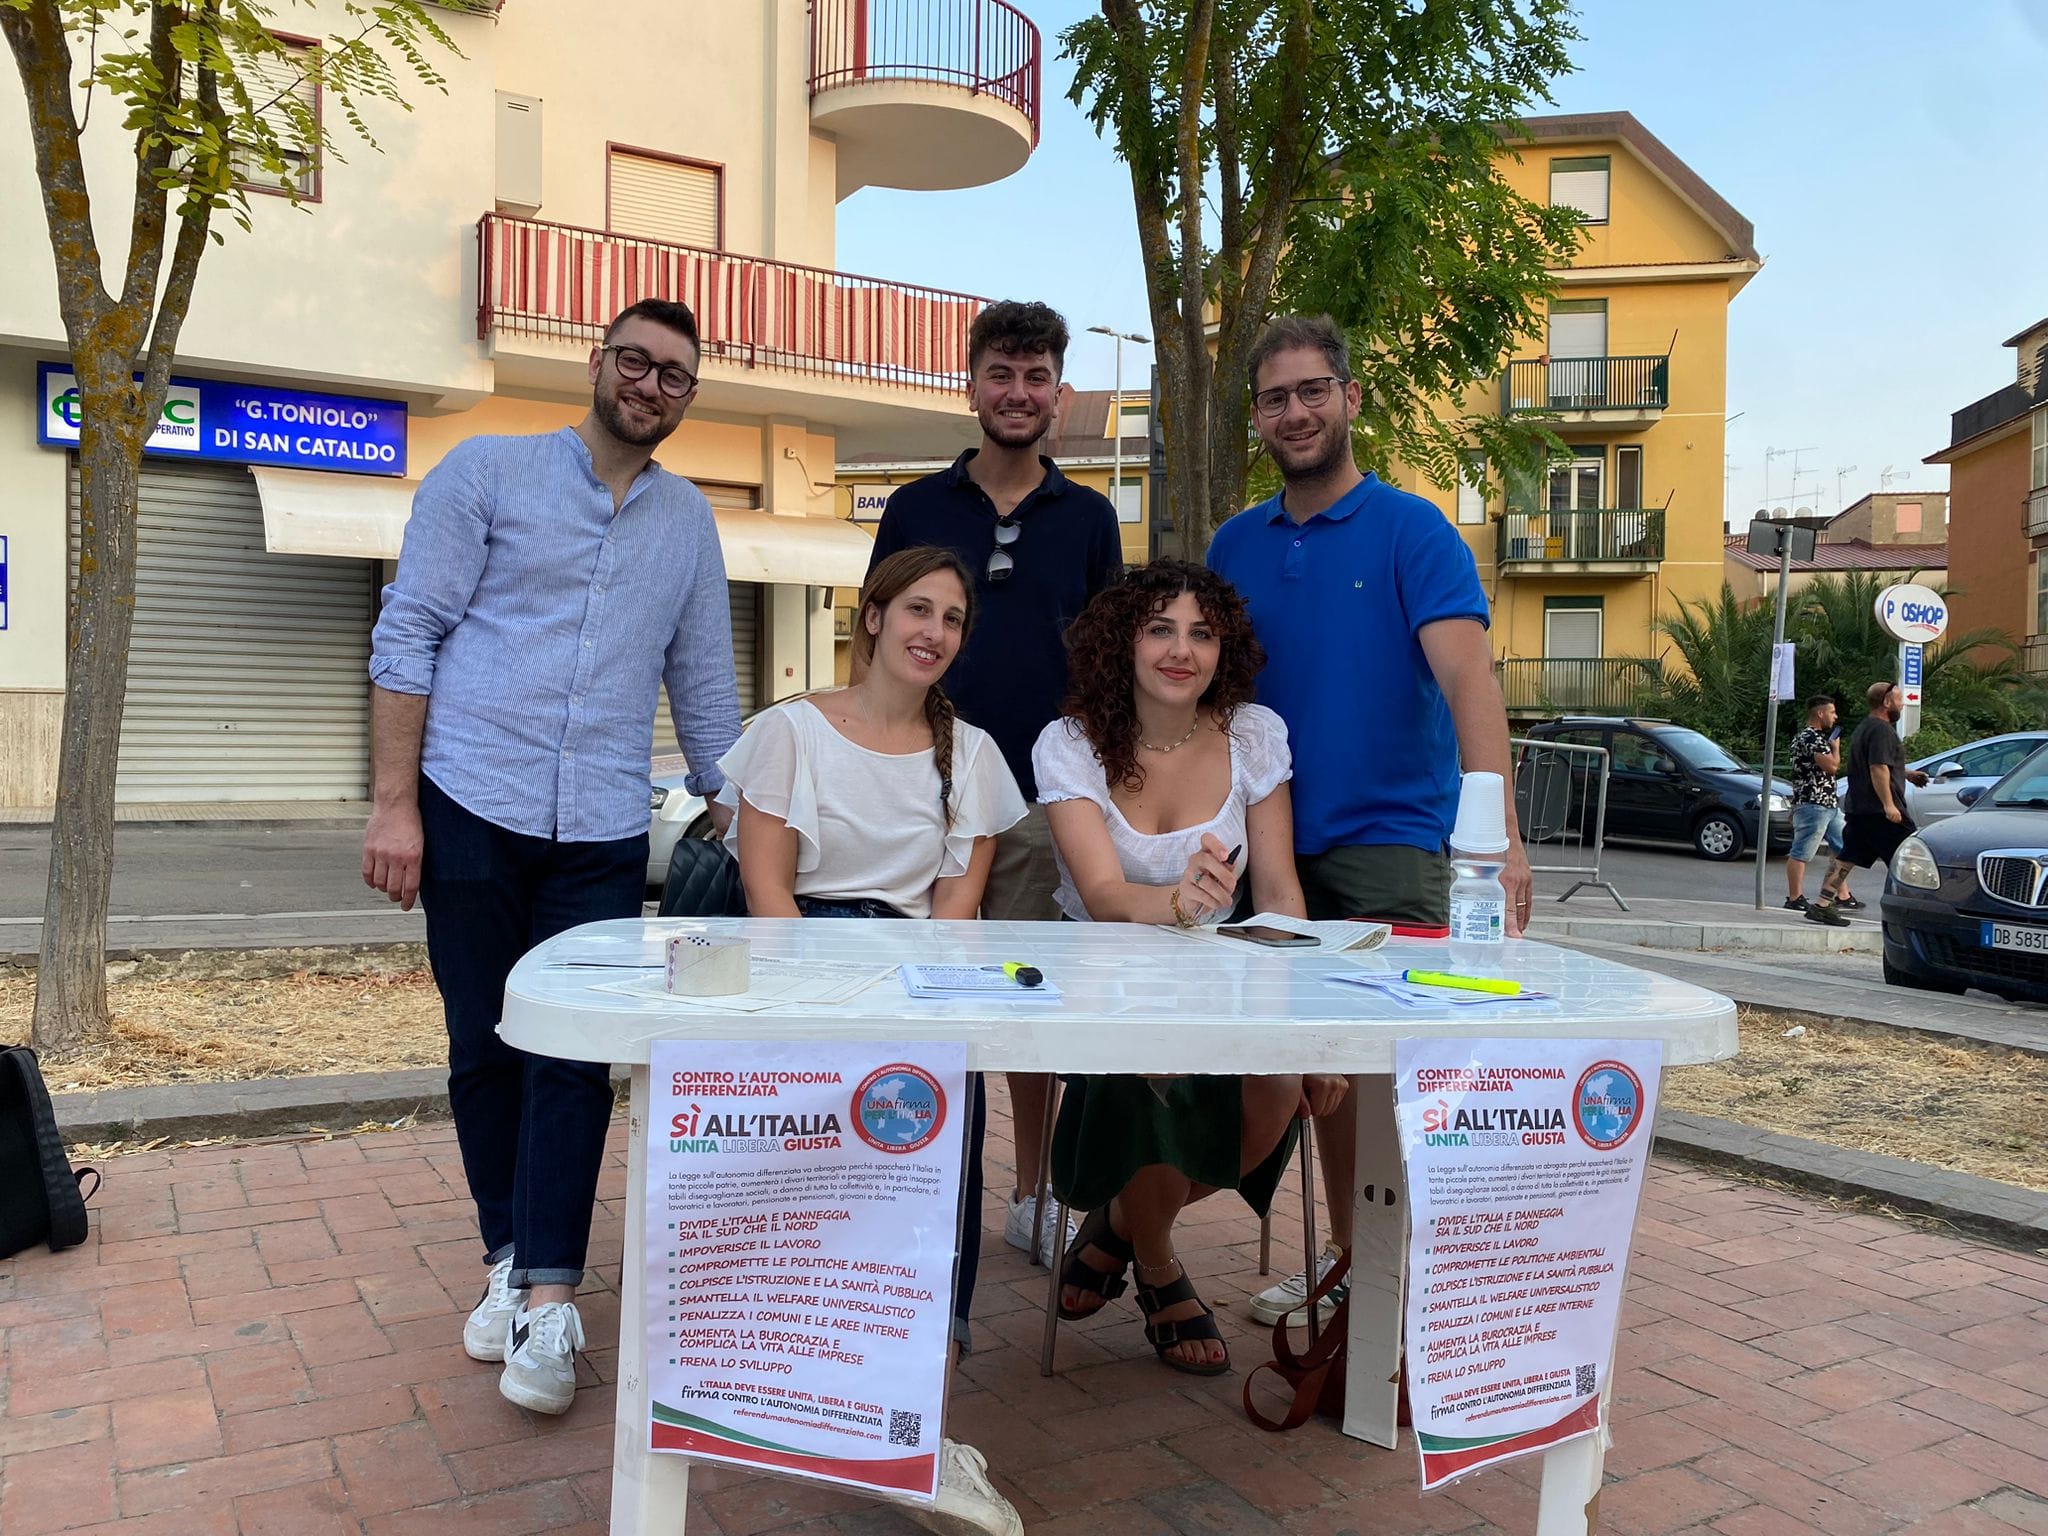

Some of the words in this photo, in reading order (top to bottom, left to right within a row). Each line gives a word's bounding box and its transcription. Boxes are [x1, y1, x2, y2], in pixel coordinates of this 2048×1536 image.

[156, 424, 194, 436] PERATIVO
[216, 428, 237, 448] DI
[244, 432, 289, 452] SAN
[296, 437, 396, 462] CATALDO
[857, 496, 888, 508] BAN
[2016, 931, 2048, 950] 583D
[672, 1071, 734, 1083] CONTRO
[739, 1072, 842, 1083] L'AUTONOMIA
[1416, 1068, 1473, 1080] CONTRO
[1478, 1068, 1565, 1079] L'AUTONOMIA
[1417, 1080, 1513, 1092] DIFFERENZIATA
[672, 1084, 778, 1096] DIFFERENZIATA
[670, 1104, 701, 1138] SÌ
[702, 1114, 842, 1137] ALL'ITALIA
[1423, 1100, 1448, 1132] SÌ
[1454, 1109, 1566, 1130] ALL'ITALIA
[670, 1139, 718, 1152] UNITA
[722, 1138, 780, 1153] LIBERA
[783, 1136, 841, 1151] GIUSTA
[1425, 1133, 1469, 1146] UNITA
[1471, 1132, 1519, 1146] LIBERA
[1521, 1131, 1565, 1145] GIUSTA
[679, 1218, 718, 1230] DIVIDE
[721, 1214, 767, 1226] L'ITALIA
[771, 1212, 779, 1222] E
[782, 1210, 850, 1221] DANNEGGIA
[1435, 1226, 1450, 1237] SIA
[1452, 1226, 1461, 1235] IL
[1462, 1225, 1482, 1235] SUD
[1483, 1223, 1503, 1233] CHE
[1503, 1222, 1511, 1231] IL
[1513, 1220, 1539, 1230] NORD
[1437, 1214, 1468, 1226] DIVIDE
[1469, 1212, 1503, 1224] L'ITALIA
[1506, 1211, 1513, 1221] E
[1514, 1207, 1563, 1220] DANNEGGIA
[679, 1231, 698, 1241] SIA
[701, 1229, 712, 1238] IL
[715, 1226, 740, 1237] SUD
[743, 1224, 767, 1234] CHE
[770, 1223, 781, 1232] IL
[784, 1221, 818, 1231] NORD
[679, 1240, 756, 1257] IMPOVERISCE
[760, 1240, 770, 1249] IL
[774, 1238, 821, 1249] LAVORO
[1432, 1241, 1491, 1255] IMPOVERISCE
[1492, 1241, 1501, 1250] IL
[1502, 1237, 1538, 1249] LAVORO
[679, 1257, 769, 1274] COMPROMETTE
[772, 1257, 787, 1266] LE
[790, 1257, 848, 1270] POLITICHE
[850, 1261, 916, 1278] AMBIENTALI
[1431, 1257, 1497, 1275] COMPROMETTE
[1498, 1256, 1510, 1266] LE
[1511, 1252, 1556, 1265] POLITICHE
[1556, 1247, 1605, 1261] AMBIENTALI
[679, 1275, 733, 1290] COLPISCE
[736, 1274, 811, 1286] L'ISTRUZIONE
[813, 1276, 821, 1286] E
[823, 1277, 838, 1288] LA
[841, 1279, 879, 1294] SANITÀ
[883, 1284, 933, 1302] PUBBLICA
[1430, 1278, 1468, 1294] COLPISCE
[1468, 1272, 1524, 1287] L'ISTRUZIONE
[1524, 1271, 1532, 1280] E
[1532, 1270, 1544, 1280] LA
[1546, 1264, 1576, 1279] SANITÀ
[1577, 1262, 1613, 1275] PUBBLICA
[679, 1292, 749, 1305] SMANTELLA
[753, 1292, 763, 1302] IL
[766, 1293, 819, 1306] WELFARE
[822, 1297, 915, 1319] UNIVERSALISTICO
[1428, 1296, 1477, 1313] SMANTELLA
[1479, 1294, 1487, 1304] IL
[1490, 1288, 1528, 1303] WELFARE
[1529, 1281, 1600, 1297] UNIVERSALISTICO
[680, 1310, 745, 1321] PENALIZZA
[749, 1311, 752, 1320] I
[756, 1310, 801, 1323] COMUNI
[804, 1314, 812, 1324] E
[814, 1315, 828, 1327] LE
[830, 1318, 860, 1331] AREE
[863, 1322, 909, 1339] INTERNE
[1428, 1315, 1473, 1332] PENALIZZA
[1475, 1313, 1479, 1323] I
[1480, 1308, 1513, 1322] COMUNI
[1514, 1307, 1521, 1317] E
[1522, 1305, 1533, 1316] LE
[1533, 1302, 1557, 1314] AREE
[1558, 1299, 1594, 1311] INTERNE
[679, 1328, 736, 1338] AUMENTA
[740, 1329, 755, 1339] LA
[759, 1330, 829, 1348] BUROCRAZIA
[832, 1339, 840, 1349] E
[1426, 1335, 1466, 1352] AUMENTA
[1468, 1333, 1479, 1344] LA
[1481, 1323, 1532, 1341] BUROCRAZIA
[1534, 1322, 1540, 1332] E
[1426, 1347, 1467, 1364] COMPLICA
[1469, 1343, 1480, 1355] LA
[1482, 1340, 1500, 1352] VITA
[1501, 1336, 1522, 1348] ALLE
[1523, 1330, 1557, 1344] IMPRESE
[679, 1339, 738, 1349] COMPLICA
[741, 1340, 756, 1350] LA
[760, 1341, 784, 1353] VITA
[787, 1344, 815, 1357] ALLE
[818, 1348, 864, 1365] IMPRESE
[680, 1356, 717, 1367] FRENA
[720, 1358, 736, 1368] LO
[739, 1359, 792, 1374] SVILUPPO
[1427, 1369, 1453, 1384] FRENA
[1454, 1366, 1466, 1377] LO
[1467, 1358, 1505, 1375] SVILUPPO
[699, 1380, 732, 1389] L'ITALIA
[734, 1382, 755, 1392] DEVE
[757, 1385, 786, 1397] ESSERE
[788, 1390, 815, 1402] UNITA,
[818, 1395, 845, 1408] LIBERA
[847, 1400, 852, 1408] E
[854, 1402, 883, 1415] GIUSTA
[1441, 1391, 1463, 1404] L'ITALIA
[1463, 1387, 1479, 1398] DEVE
[1480, 1384, 1501, 1394] ESSERE
[1502, 1380, 1522, 1389] UNITA,
[1523, 1374, 1543, 1384] LIBERA
[1544, 1372, 1548, 1380] E
[1549, 1368, 1570, 1379] GIUSTA
[681, 1386, 719, 1400] firma
[721, 1392, 758, 1404] CONTRO
[760, 1397, 820, 1415] L'AUTONOMIA
[822, 1408, 882, 1427] DIFFERENZIATA
[1431, 1404, 1455, 1420] firma
[1456, 1398, 1482, 1411] CONTRO
[1483, 1388, 1526, 1404] L'AUTONOMIA
[1527, 1379, 1571, 1394] DIFFERENZIATA
[733, 1408, 882, 1441] referendumautonomiadifferenziata.com
